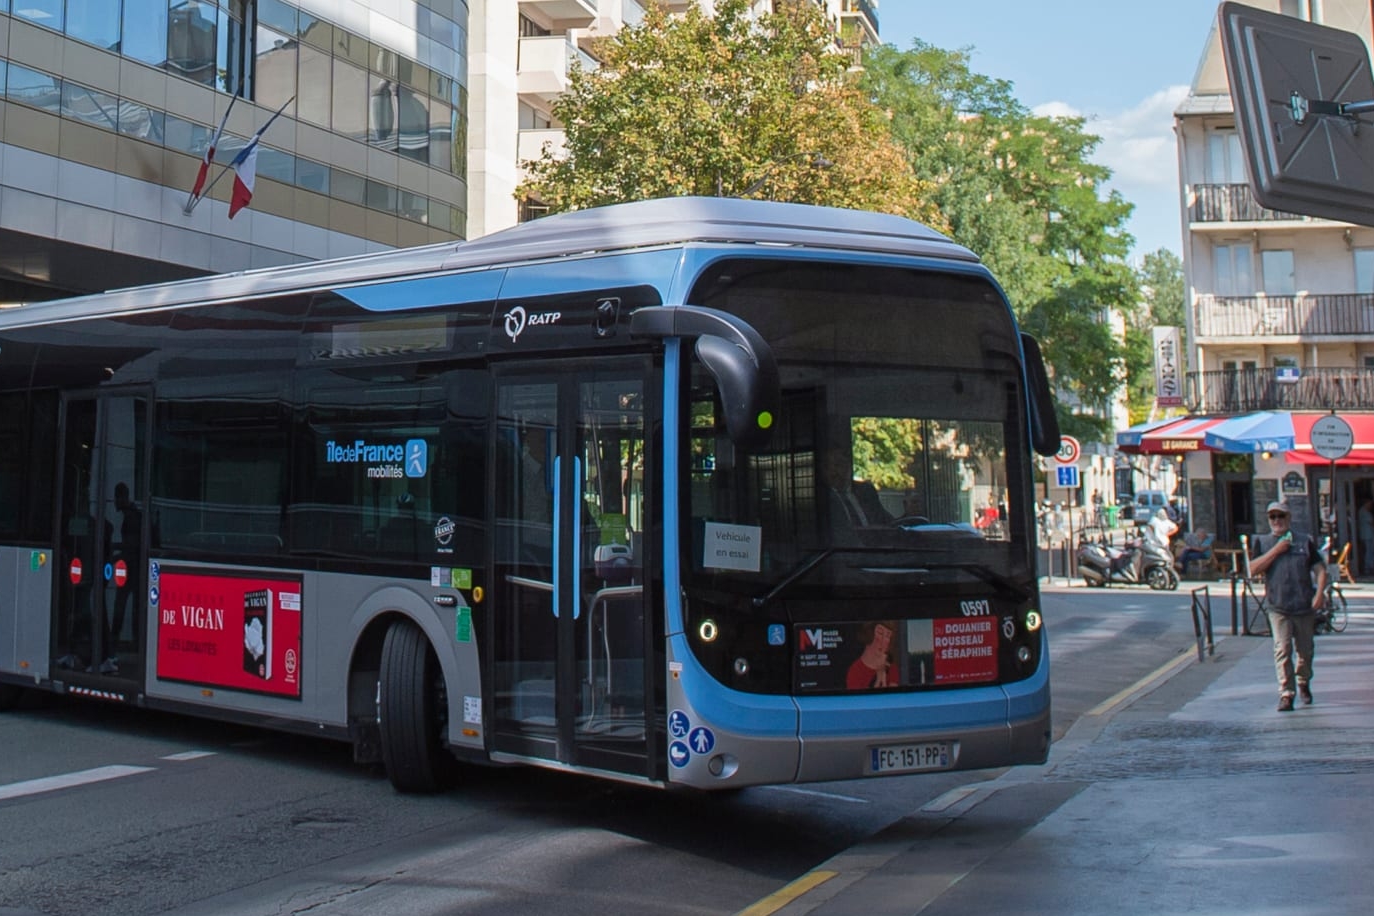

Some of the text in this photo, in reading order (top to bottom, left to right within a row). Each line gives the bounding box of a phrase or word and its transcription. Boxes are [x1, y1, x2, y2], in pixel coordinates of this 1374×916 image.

[528, 312, 561, 326] RATP
[367, 464, 403, 478] mobilités
[716, 549, 749, 559] en essai
[250, 597, 267, 608] VIGAN
[960, 600, 990, 617] 0597
[162, 605, 225, 631] DE VIGAN
[946, 622, 992, 633] DOUANIER
[935, 635, 984, 647] ROUSSEAU
[941, 646, 993, 659] SÉRAPHINE
[880, 747, 939, 768] FC-151-PP
